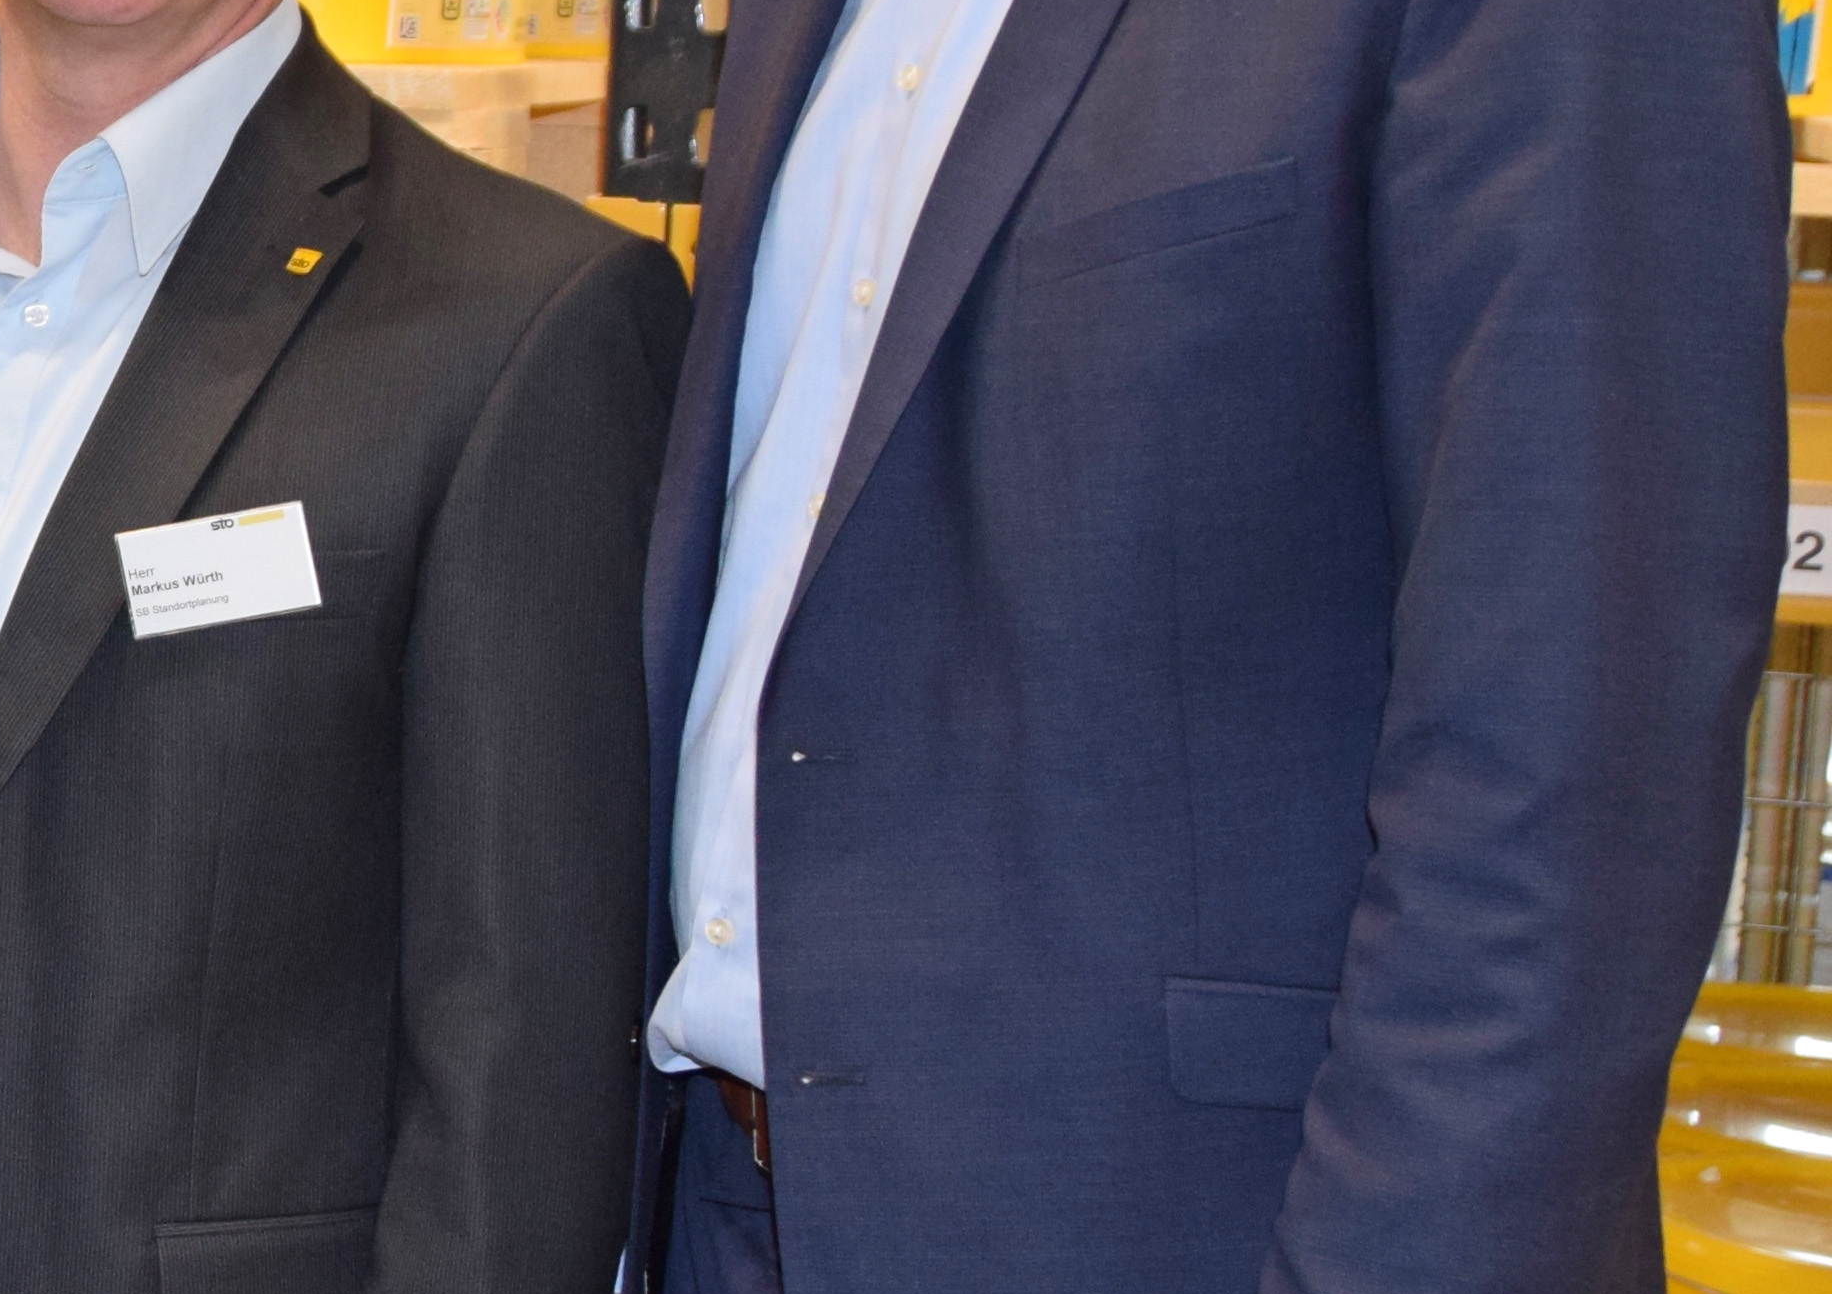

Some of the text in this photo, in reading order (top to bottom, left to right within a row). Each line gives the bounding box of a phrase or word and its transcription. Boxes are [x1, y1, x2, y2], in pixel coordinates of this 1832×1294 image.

[210, 518, 235, 532] sto
[1787, 529, 1825, 572] 2
[128, 567, 155, 581] Herr
[131, 571, 224, 597] Markus Würth
